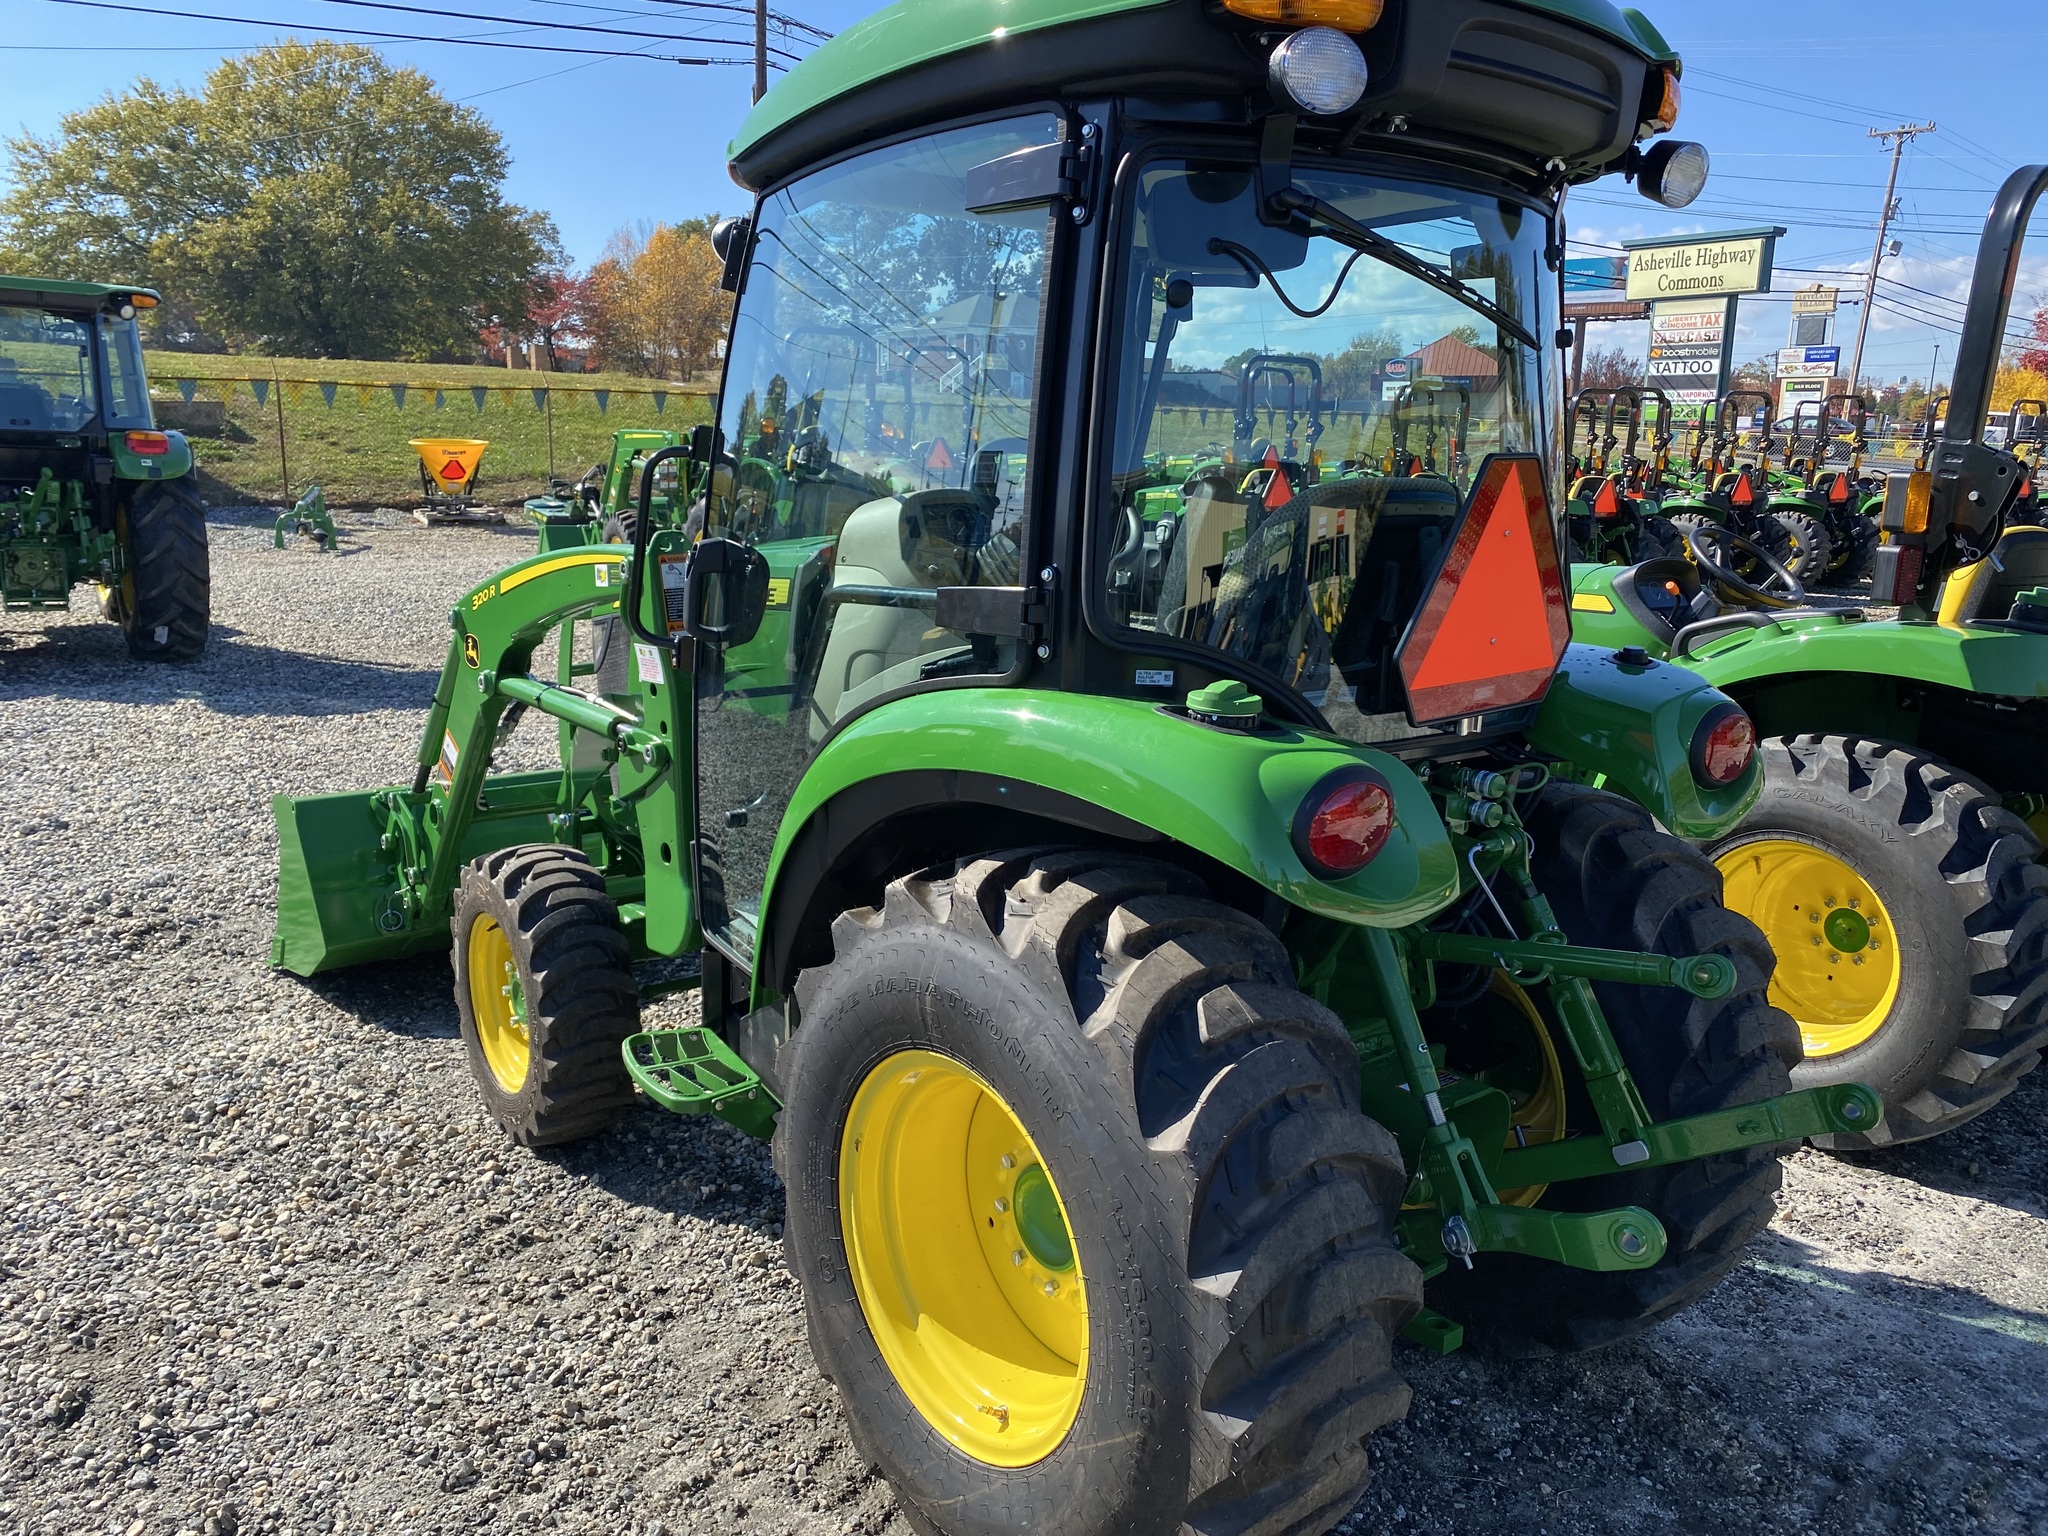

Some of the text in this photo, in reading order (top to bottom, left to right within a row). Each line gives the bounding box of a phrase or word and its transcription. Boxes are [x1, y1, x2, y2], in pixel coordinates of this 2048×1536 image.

[1633, 245, 1756, 273] Asheville Highway
[1657, 273, 1724, 292] Commons
[1667, 313, 1721, 327] LIBERTY TAX
[1654, 360, 1713, 374] TATTOO
[1773, 786, 1899, 845] GALAXY
